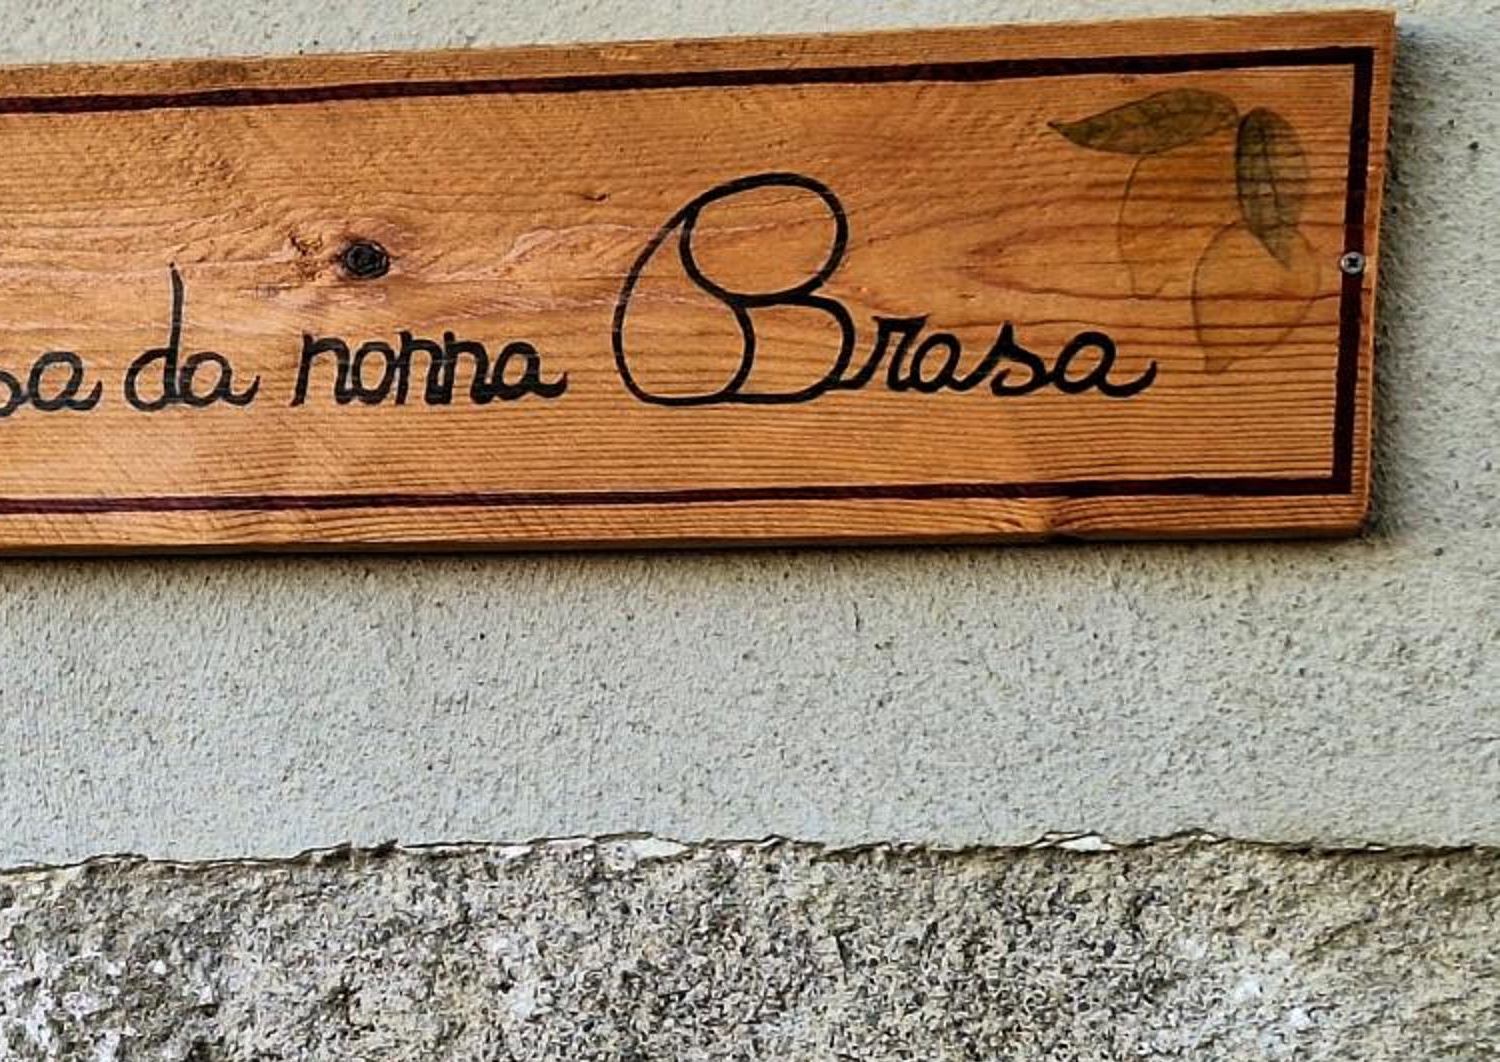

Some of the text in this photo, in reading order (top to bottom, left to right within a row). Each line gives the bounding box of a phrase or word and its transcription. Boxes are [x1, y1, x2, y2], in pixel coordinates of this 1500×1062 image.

[124, 261, 261, 413] da
[289, 330, 569, 407] nonna
[612, 171, 1158, 405] Brasa
